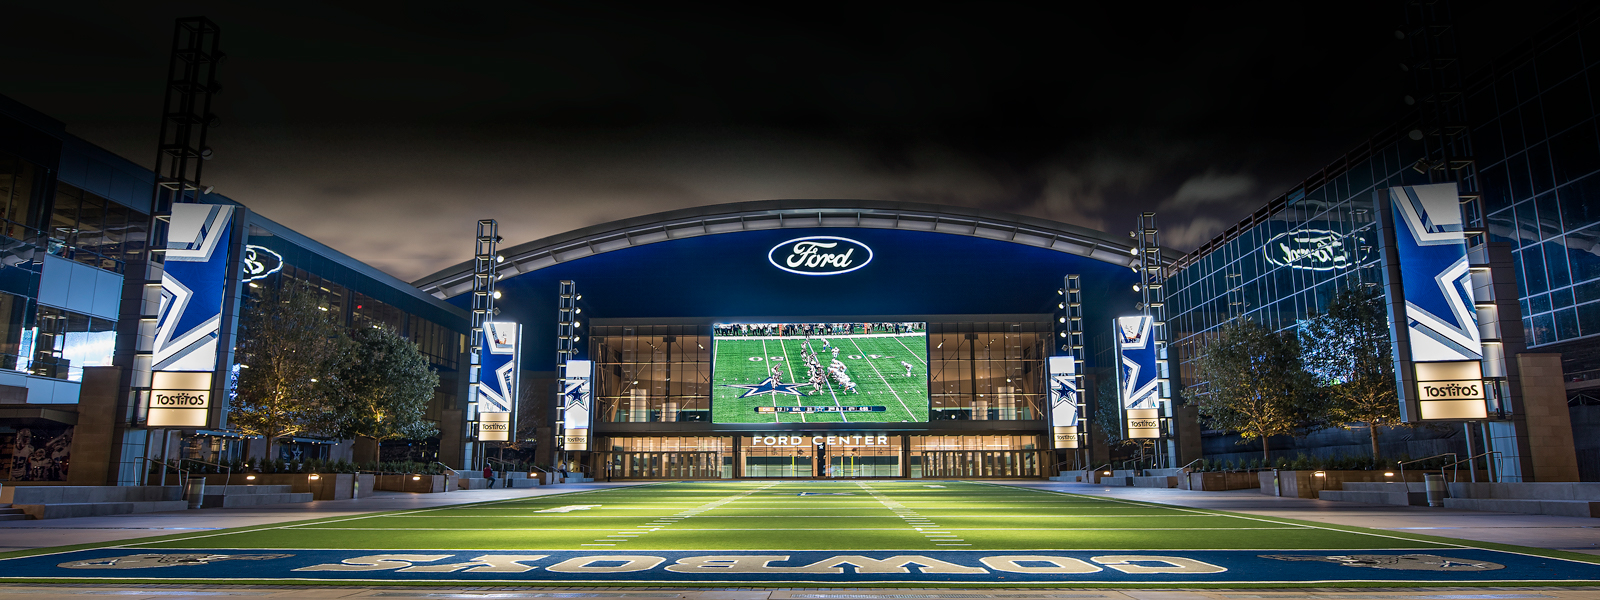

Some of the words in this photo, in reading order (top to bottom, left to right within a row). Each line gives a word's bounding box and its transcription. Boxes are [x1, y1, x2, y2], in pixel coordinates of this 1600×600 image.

[786, 241, 854, 268] Ford
[753, 435, 802, 446] FORD
[812, 435, 888, 446] CENTER
[291, 553, 1228, 575] COWBOYS
